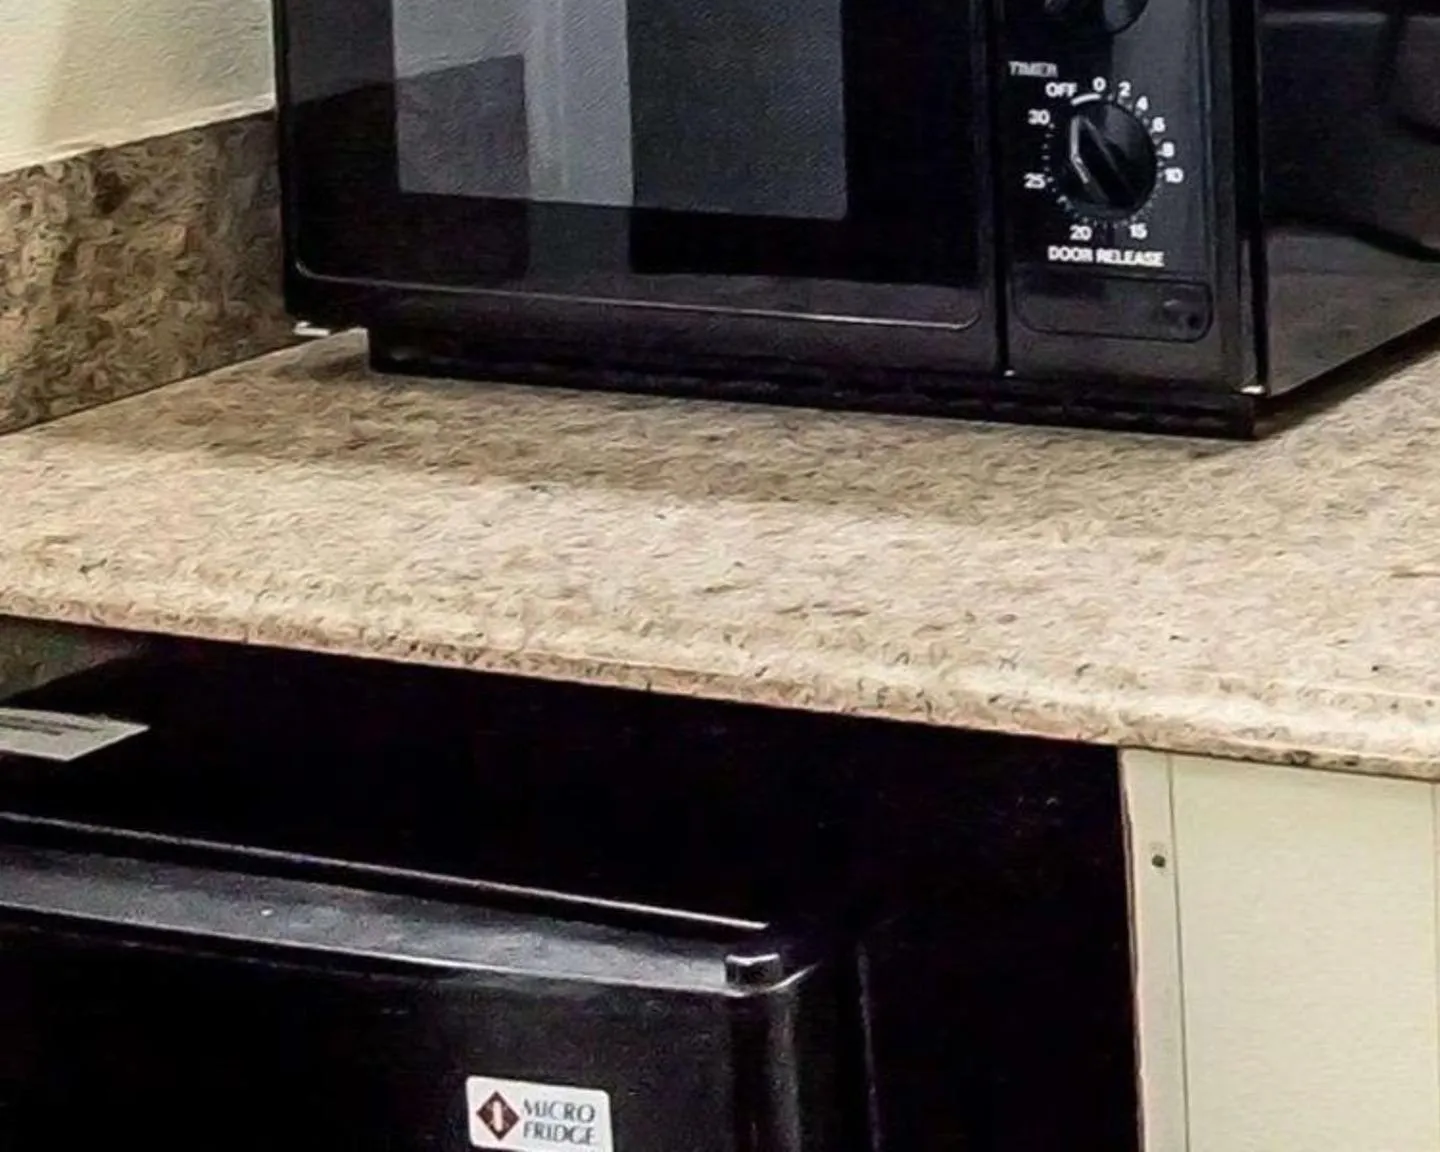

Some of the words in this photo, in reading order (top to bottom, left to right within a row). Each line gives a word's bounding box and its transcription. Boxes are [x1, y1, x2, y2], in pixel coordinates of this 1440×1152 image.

[1008, 61, 1059, 78] TIMER
[1045, 82, 1078, 98] OFF
[1093, 77, 1106, 93] 0
[1118, 81, 1131, 97] 2
[1136, 96, 1149, 111] 4
[1027, 109, 1050, 126] 30
[1024, 173, 1046, 190] 25
[1164, 167, 1184, 184] 10
[1069, 224, 1093, 241] 20
[1129, 223, 1148, 239] 15
[1048, 245, 1093, 264] DOOR
[1096, 248, 1165, 268] RELEASE
[523, 1098, 596, 1123] MICRO
[523, 1120, 595, 1145] FRIDGE
